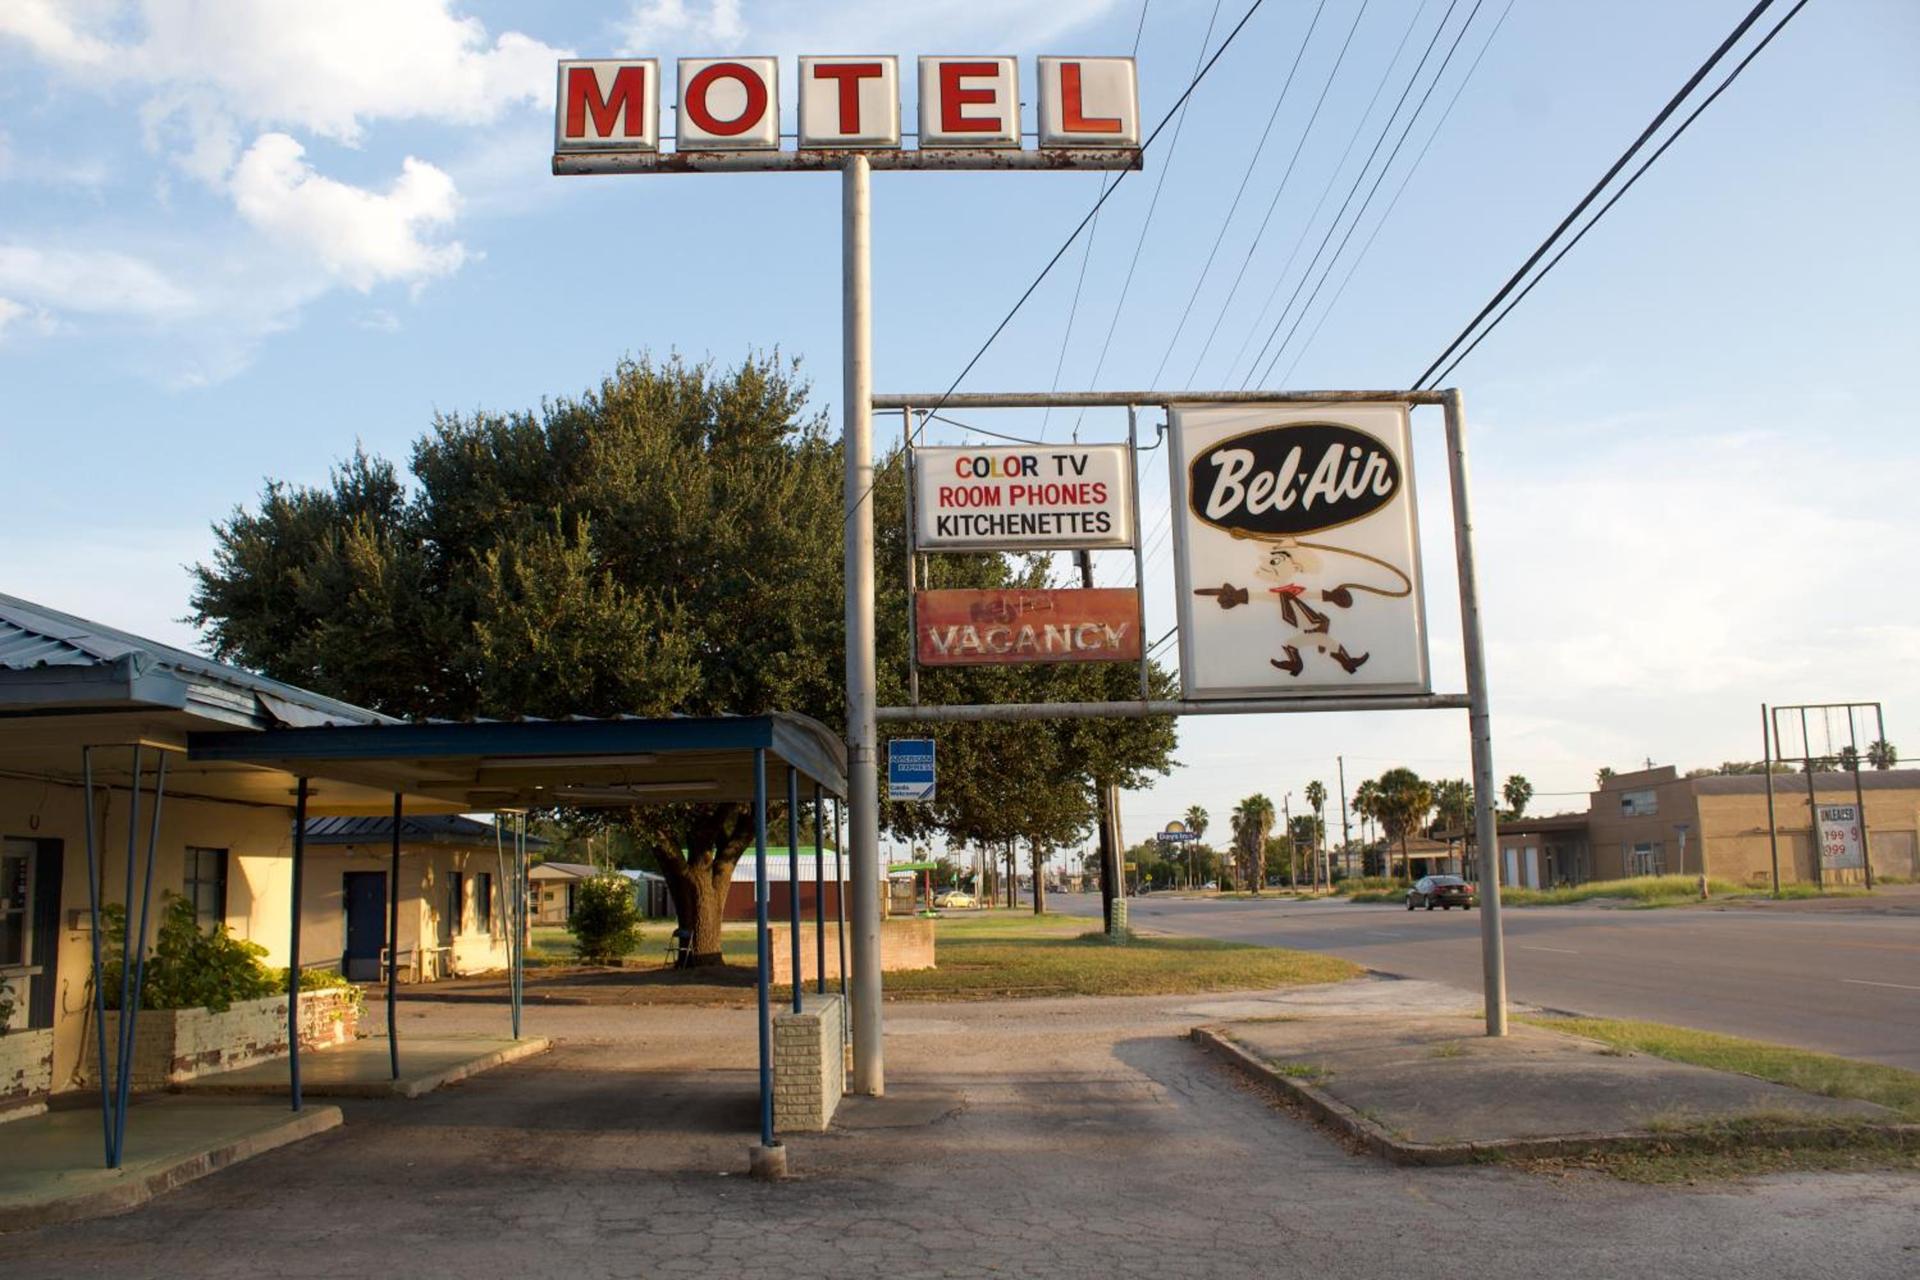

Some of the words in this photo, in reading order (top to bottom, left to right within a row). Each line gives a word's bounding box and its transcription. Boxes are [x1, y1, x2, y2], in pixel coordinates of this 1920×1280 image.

[565, 61, 1122, 138] MOTEL
[955, 455, 1039, 479] COLOR
[1052, 454, 1088, 476] TV
[939, 485, 1001, 508] ROOM
[1009, 482, 1108, 506] PHONES
[937, 511, 1111, 537] KITCHENETTES
[927, 621, 1130, 656] VACANCY
